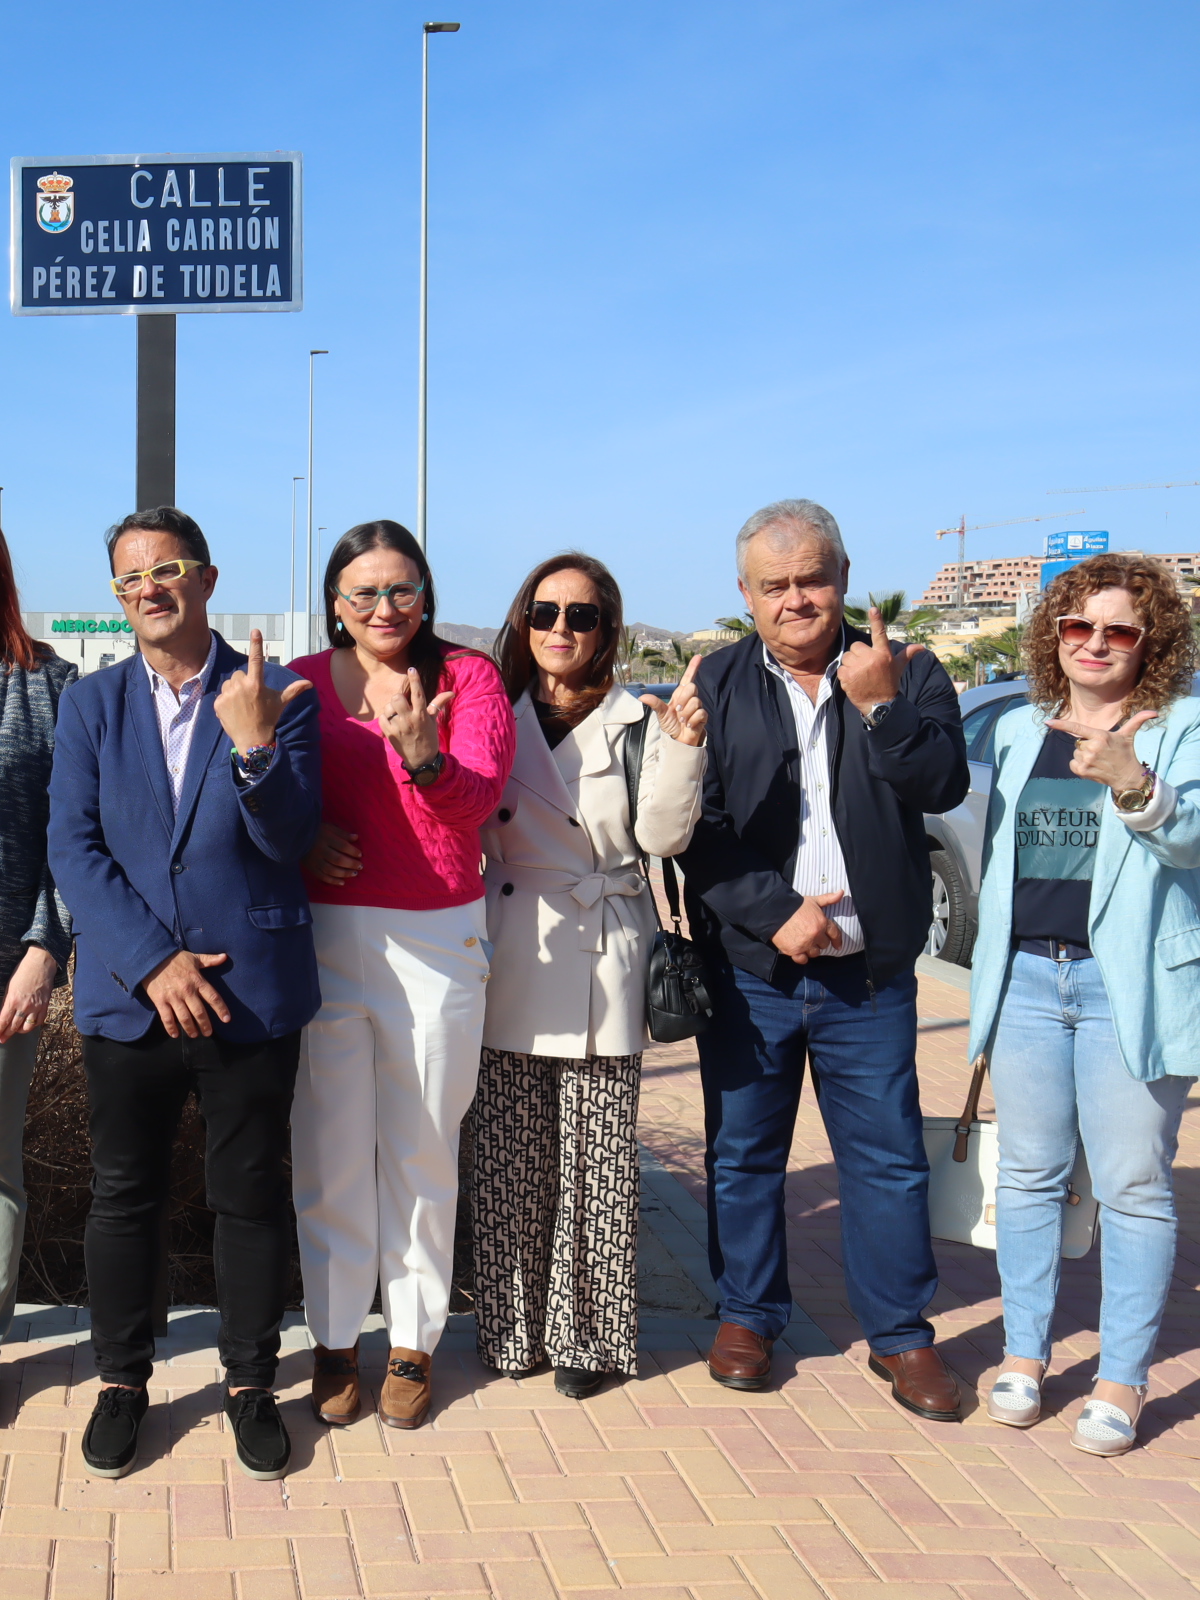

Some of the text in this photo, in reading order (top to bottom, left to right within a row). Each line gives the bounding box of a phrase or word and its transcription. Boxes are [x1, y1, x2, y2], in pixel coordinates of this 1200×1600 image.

[130, 167, 270, 209] CALLE
[80, 207, 279, 254] CELIA CARRIÓN
[32, 256, 282, 299] PÉREZ DE TUDELA
[51, 619, 134, 633] MERCADO
[1016, 830, 1056, 847] D'UN
